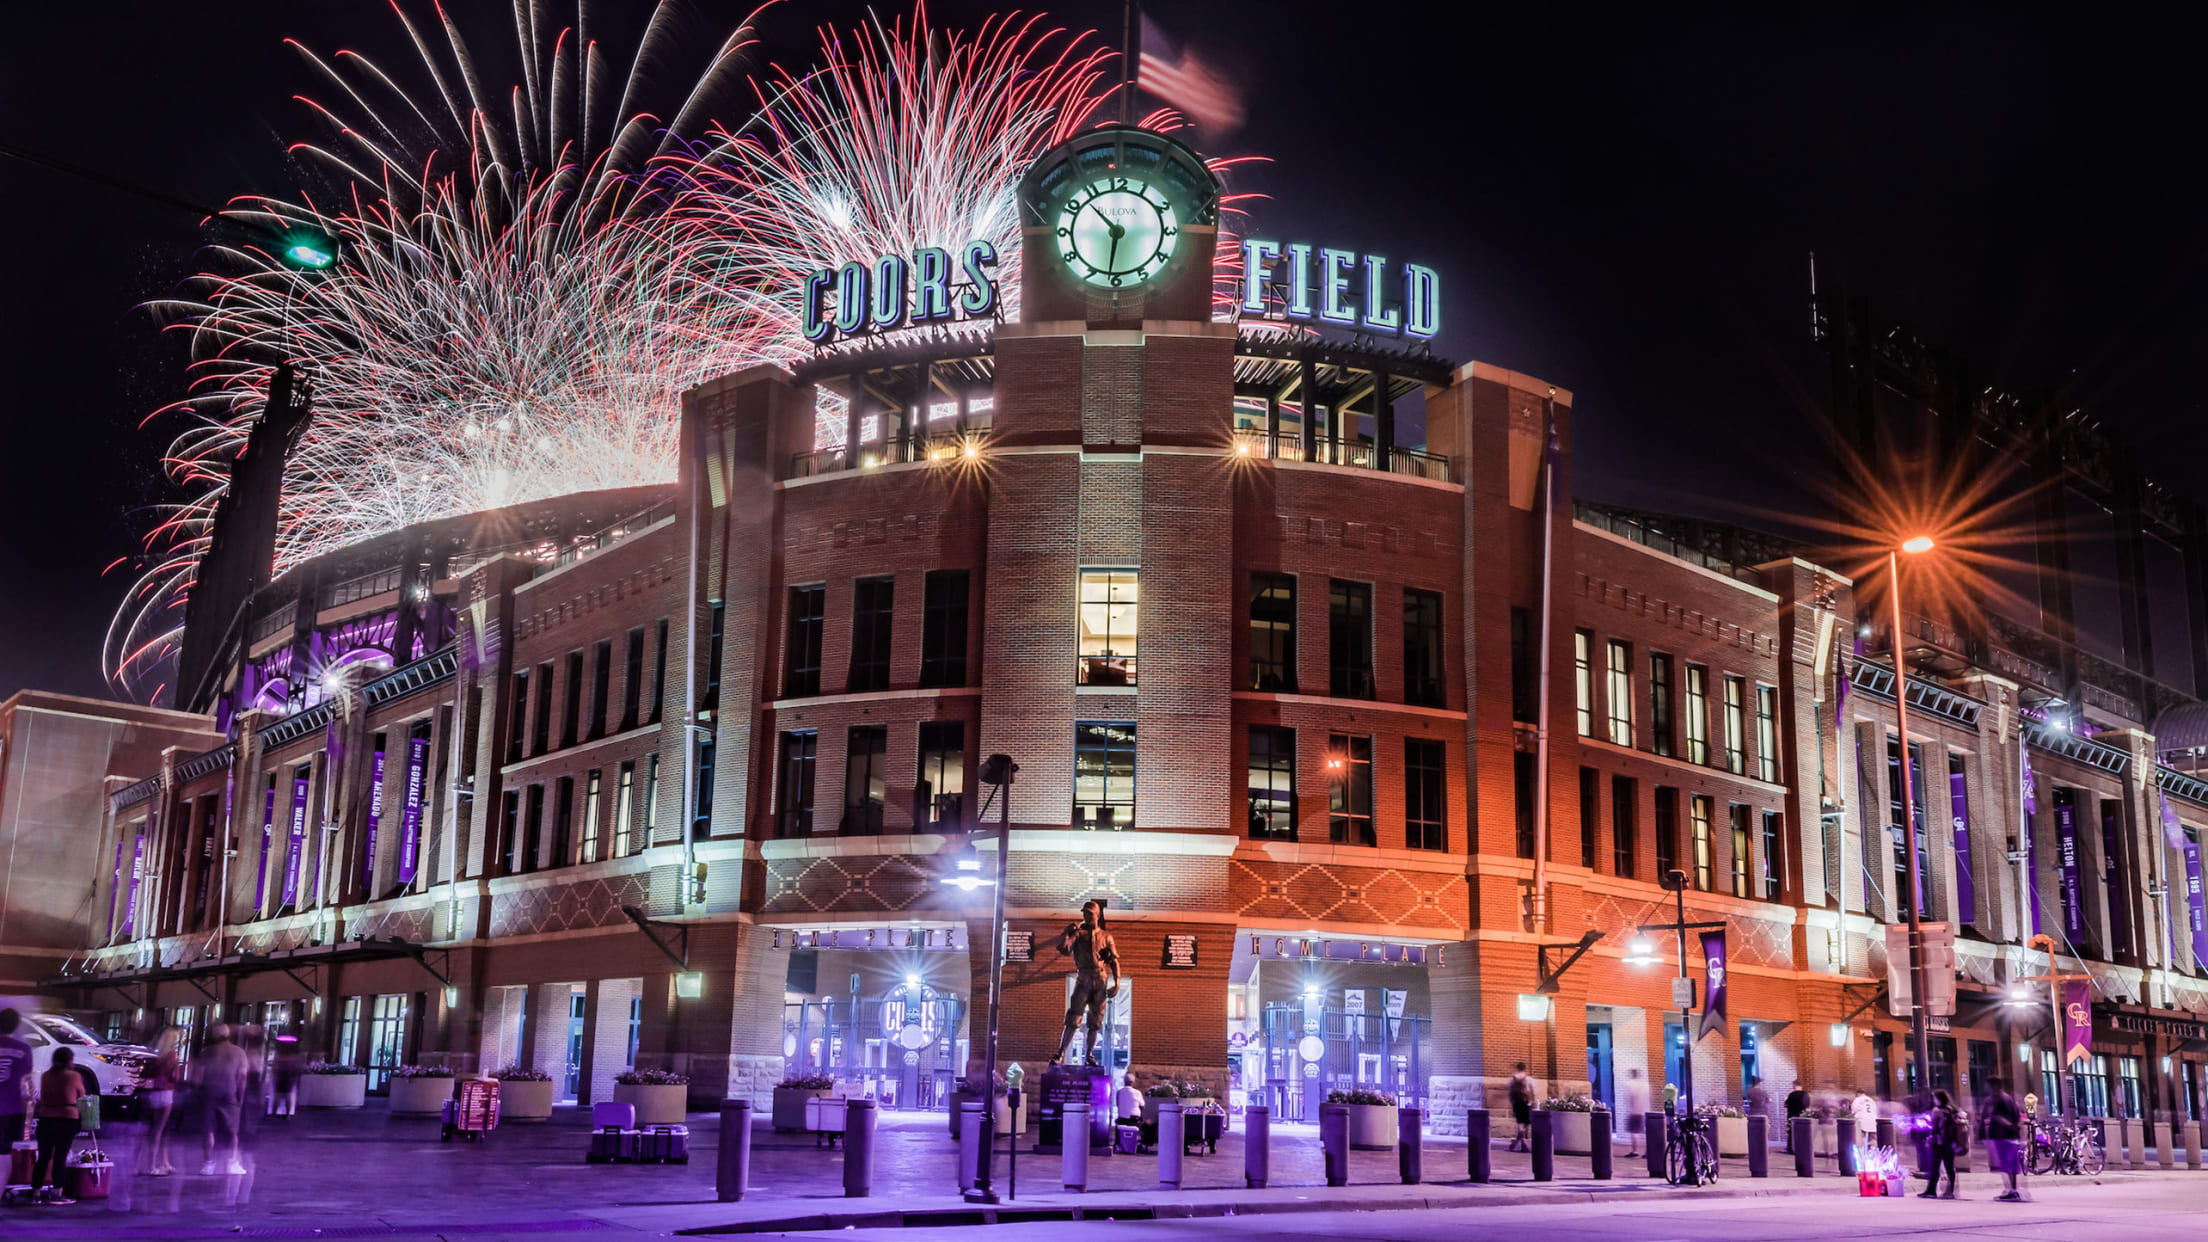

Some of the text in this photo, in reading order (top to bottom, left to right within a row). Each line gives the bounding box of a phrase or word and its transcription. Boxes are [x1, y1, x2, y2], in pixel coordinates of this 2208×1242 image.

[1085, 183, 1100, 198] 11
[1110, 178, 1128, 191] 12
[1140, 182, 1149, 196] 1
[1064, 200, 1080, 216] 10
[1098, 207, 1137, 217] BULOVA
[1156, 202, 1170, 214] 2
[1058, 227, 1071, 237] 9
[1164, 226, 1177, 236] 3
[1064, 251, 1076, 262] 8
[1158, 252, 1169, 263] 4
[1085, 268, 1098, 280] 7
[1111, 274, 1122, 287] 6
[1137, 269, 1149, 280] 5
[802, 239, 1440, 342] COORS FIELD
[408, 765, 421, 808] GONZALEZ
[371, 780, 383, 817] ARENADO
[293, 807, 304, 835] WALKER
[2063, 836, 2074, 867] HELTON
[2190, 876, 2200, 894] 1995
[772, 928, 954, 948] HOME PLATE
[1251, 936, 1446, 964] HOME PLATE
[1346, 1001, 1363, 1009] 2007
[2067, 1003, 2091, 1027] CR
